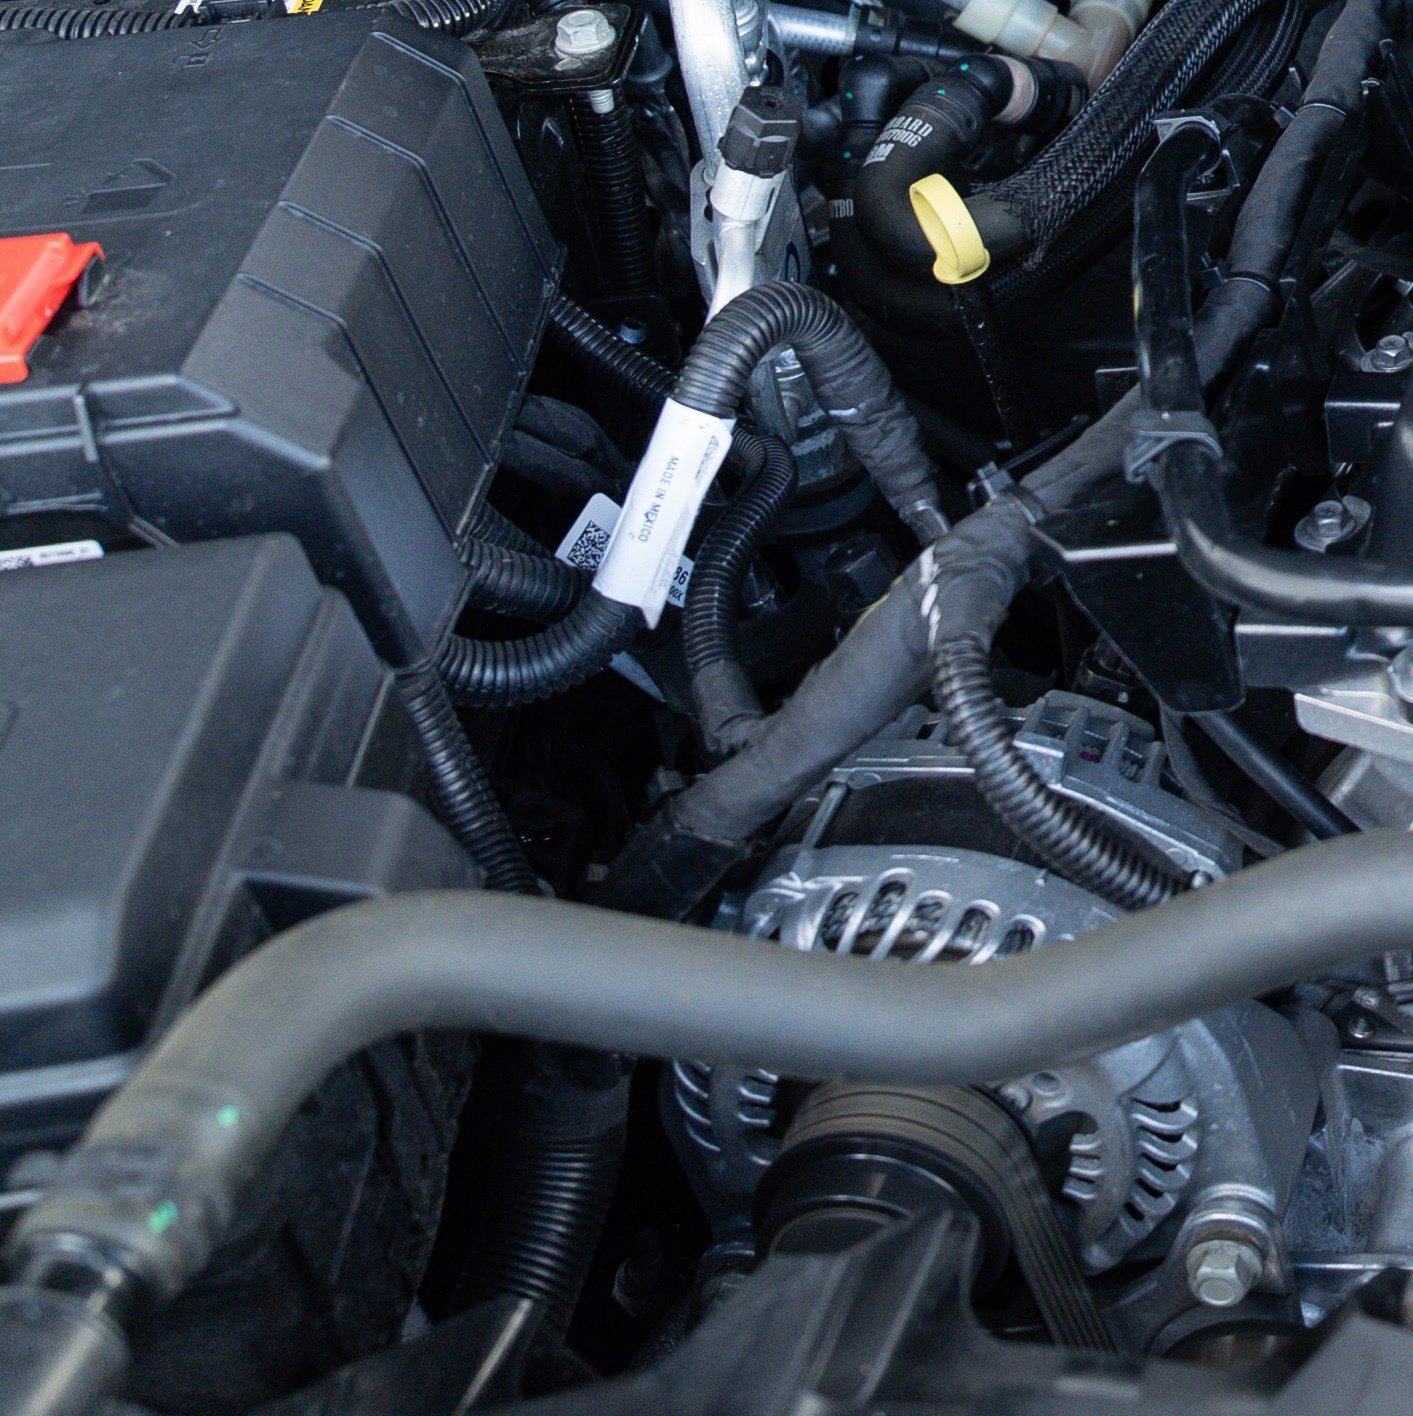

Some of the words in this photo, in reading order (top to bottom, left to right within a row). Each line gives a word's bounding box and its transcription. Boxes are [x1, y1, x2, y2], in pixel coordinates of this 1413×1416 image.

[663, 455, 680, 485] MADE
[656, 486, 668, 500] IN
[638, 502, 661, 542] MEXICO
